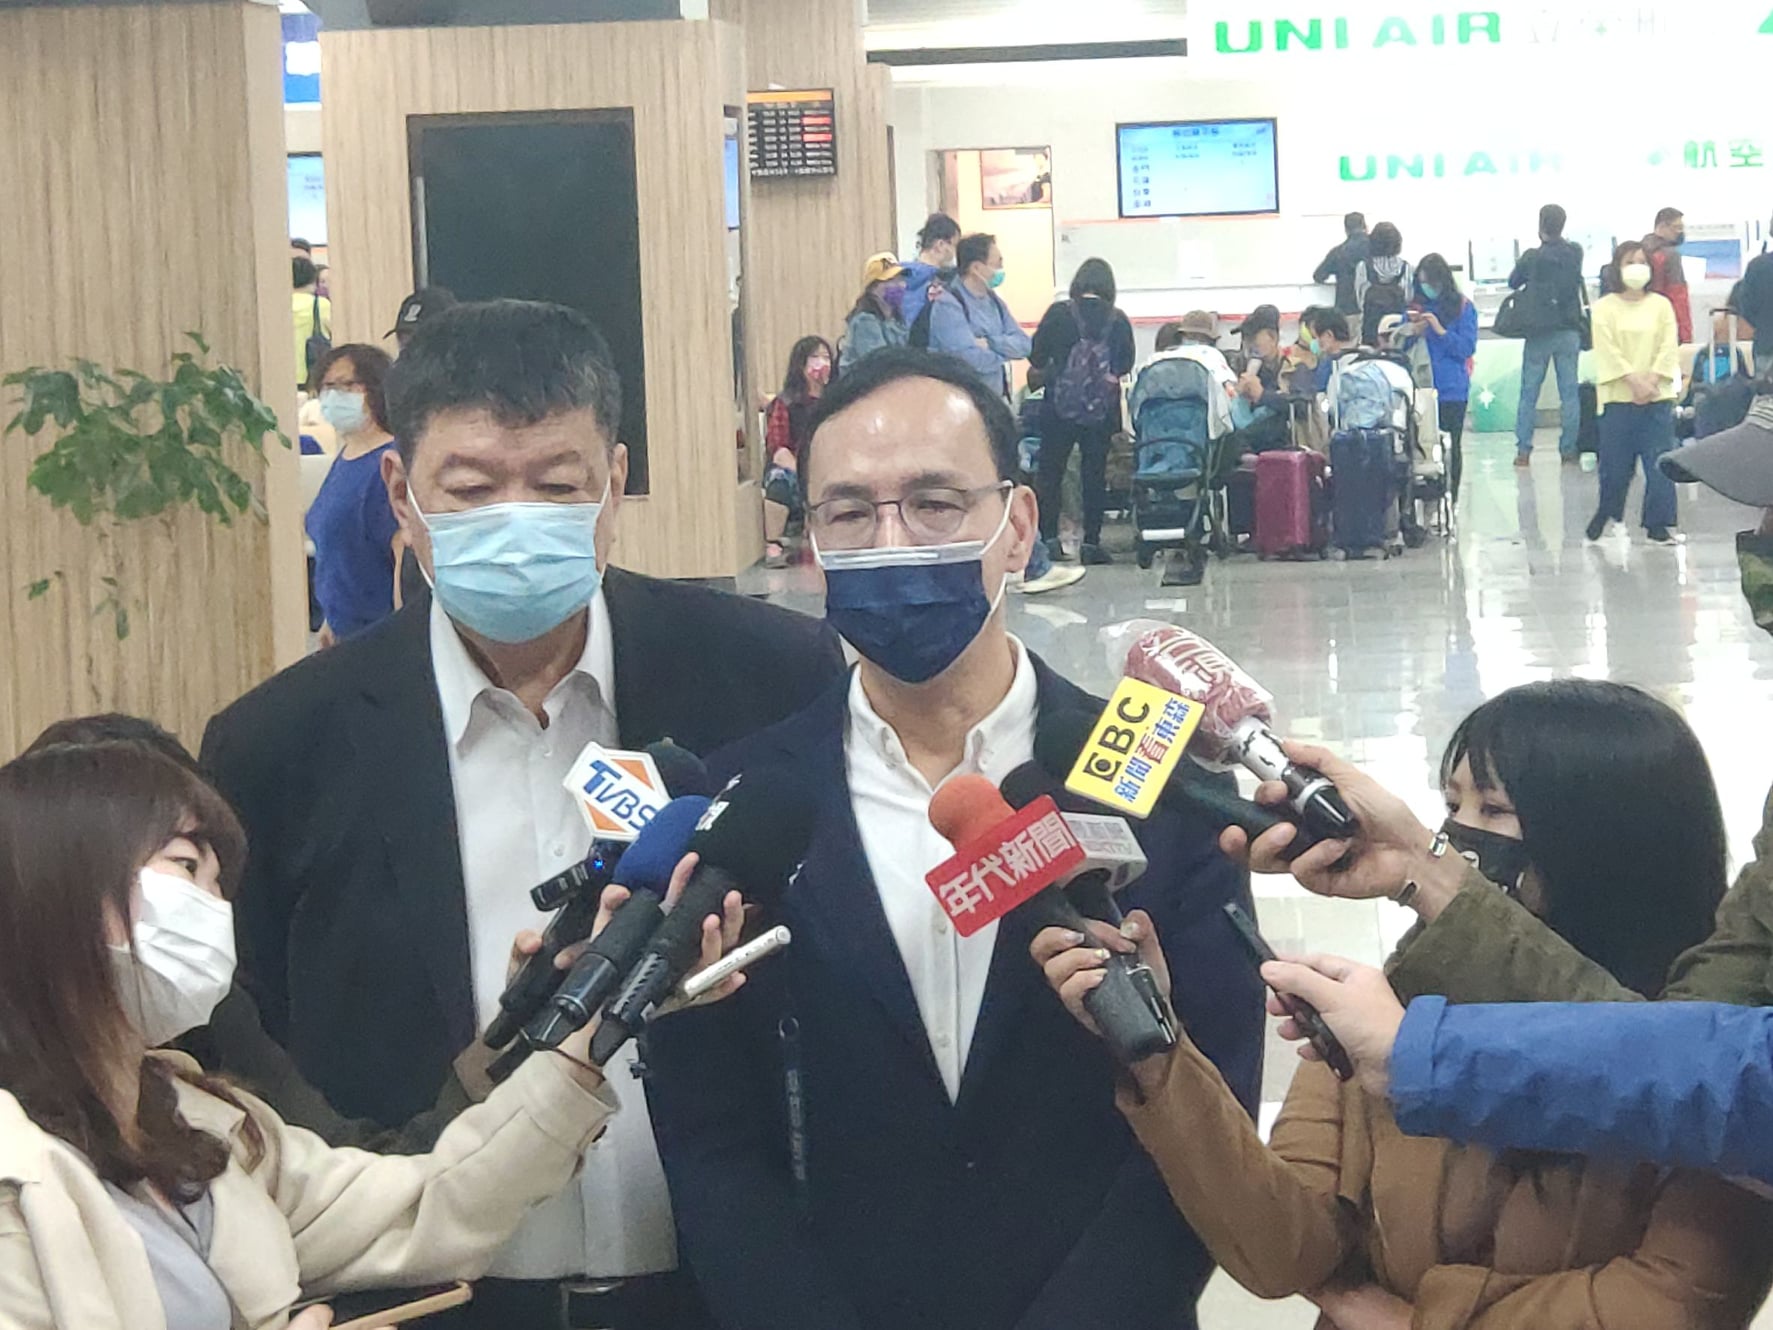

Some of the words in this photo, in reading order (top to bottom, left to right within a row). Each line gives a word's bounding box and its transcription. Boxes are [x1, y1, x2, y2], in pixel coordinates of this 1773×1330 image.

[1214, 17, 1350, 55] UNI
[1372, 11, 1502, 49] AIR
[1336, 153, 1446, 182] UNI
[1114, 697, 1191, 803] 新聞看東森
[583, 759, 658, 831] TVBS
[938, 810, 1078, 918] 年代新聞
